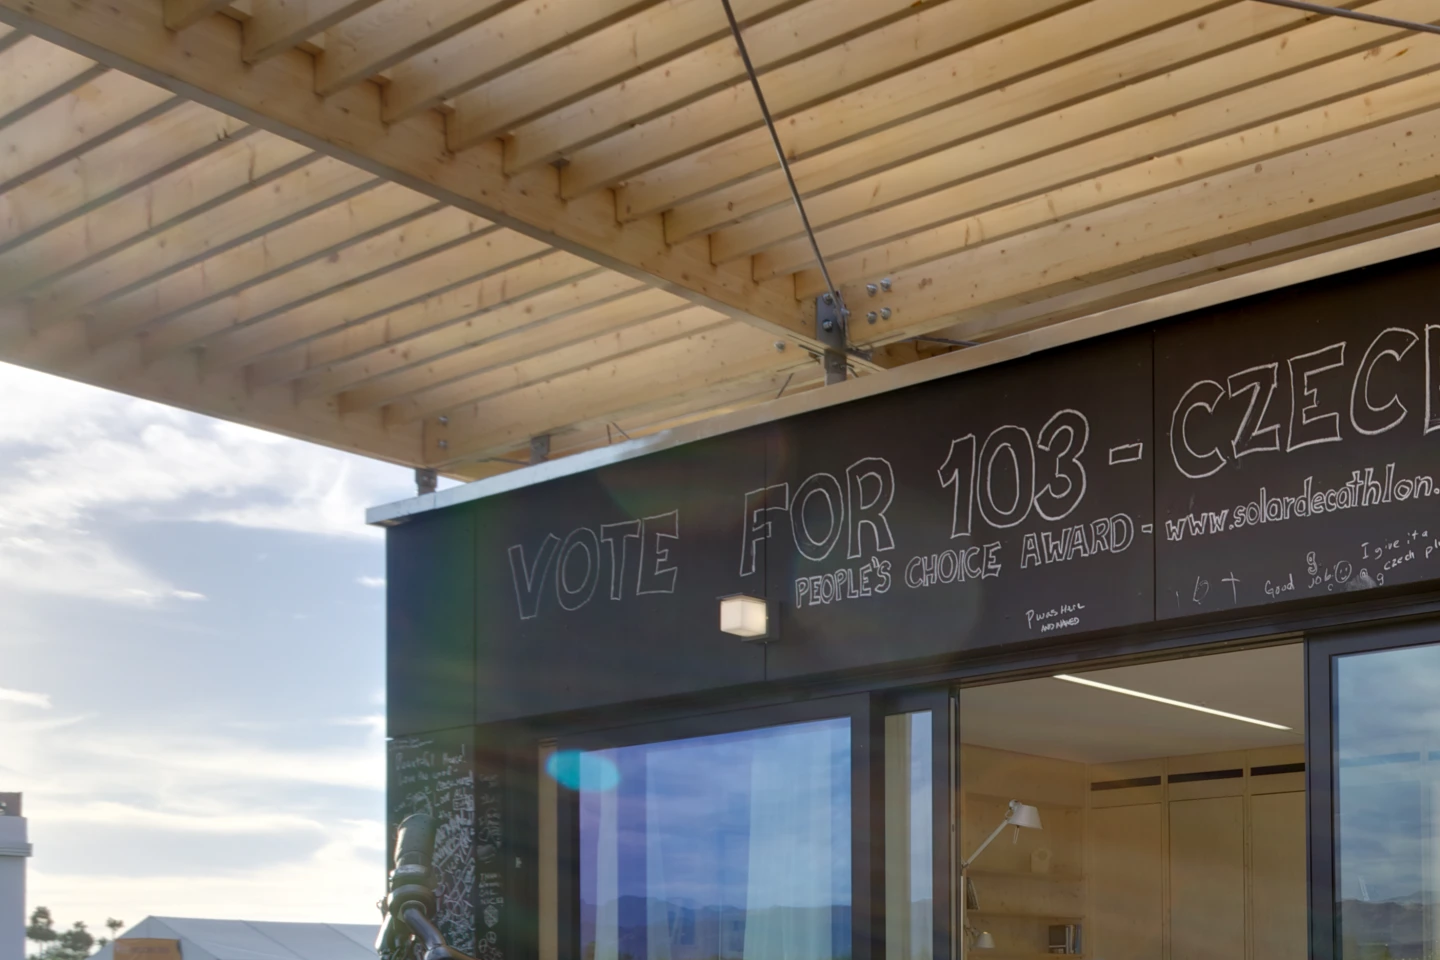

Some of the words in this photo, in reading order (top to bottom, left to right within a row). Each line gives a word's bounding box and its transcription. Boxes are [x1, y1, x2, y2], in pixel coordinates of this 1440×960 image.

[507, 509, 679, 620] VOTE
[740, 456, 895, 577] FOR
[938, 408, 1089, 539] 103
[794, 555, 892, 609] PEOPLE'S
[904, 541, 1003, 588] CHOICE
[1020, 512, 1134, 568] AWARD
[1264, 573, 1295, 598] Good
[1036, 609, 1058, 621] was
